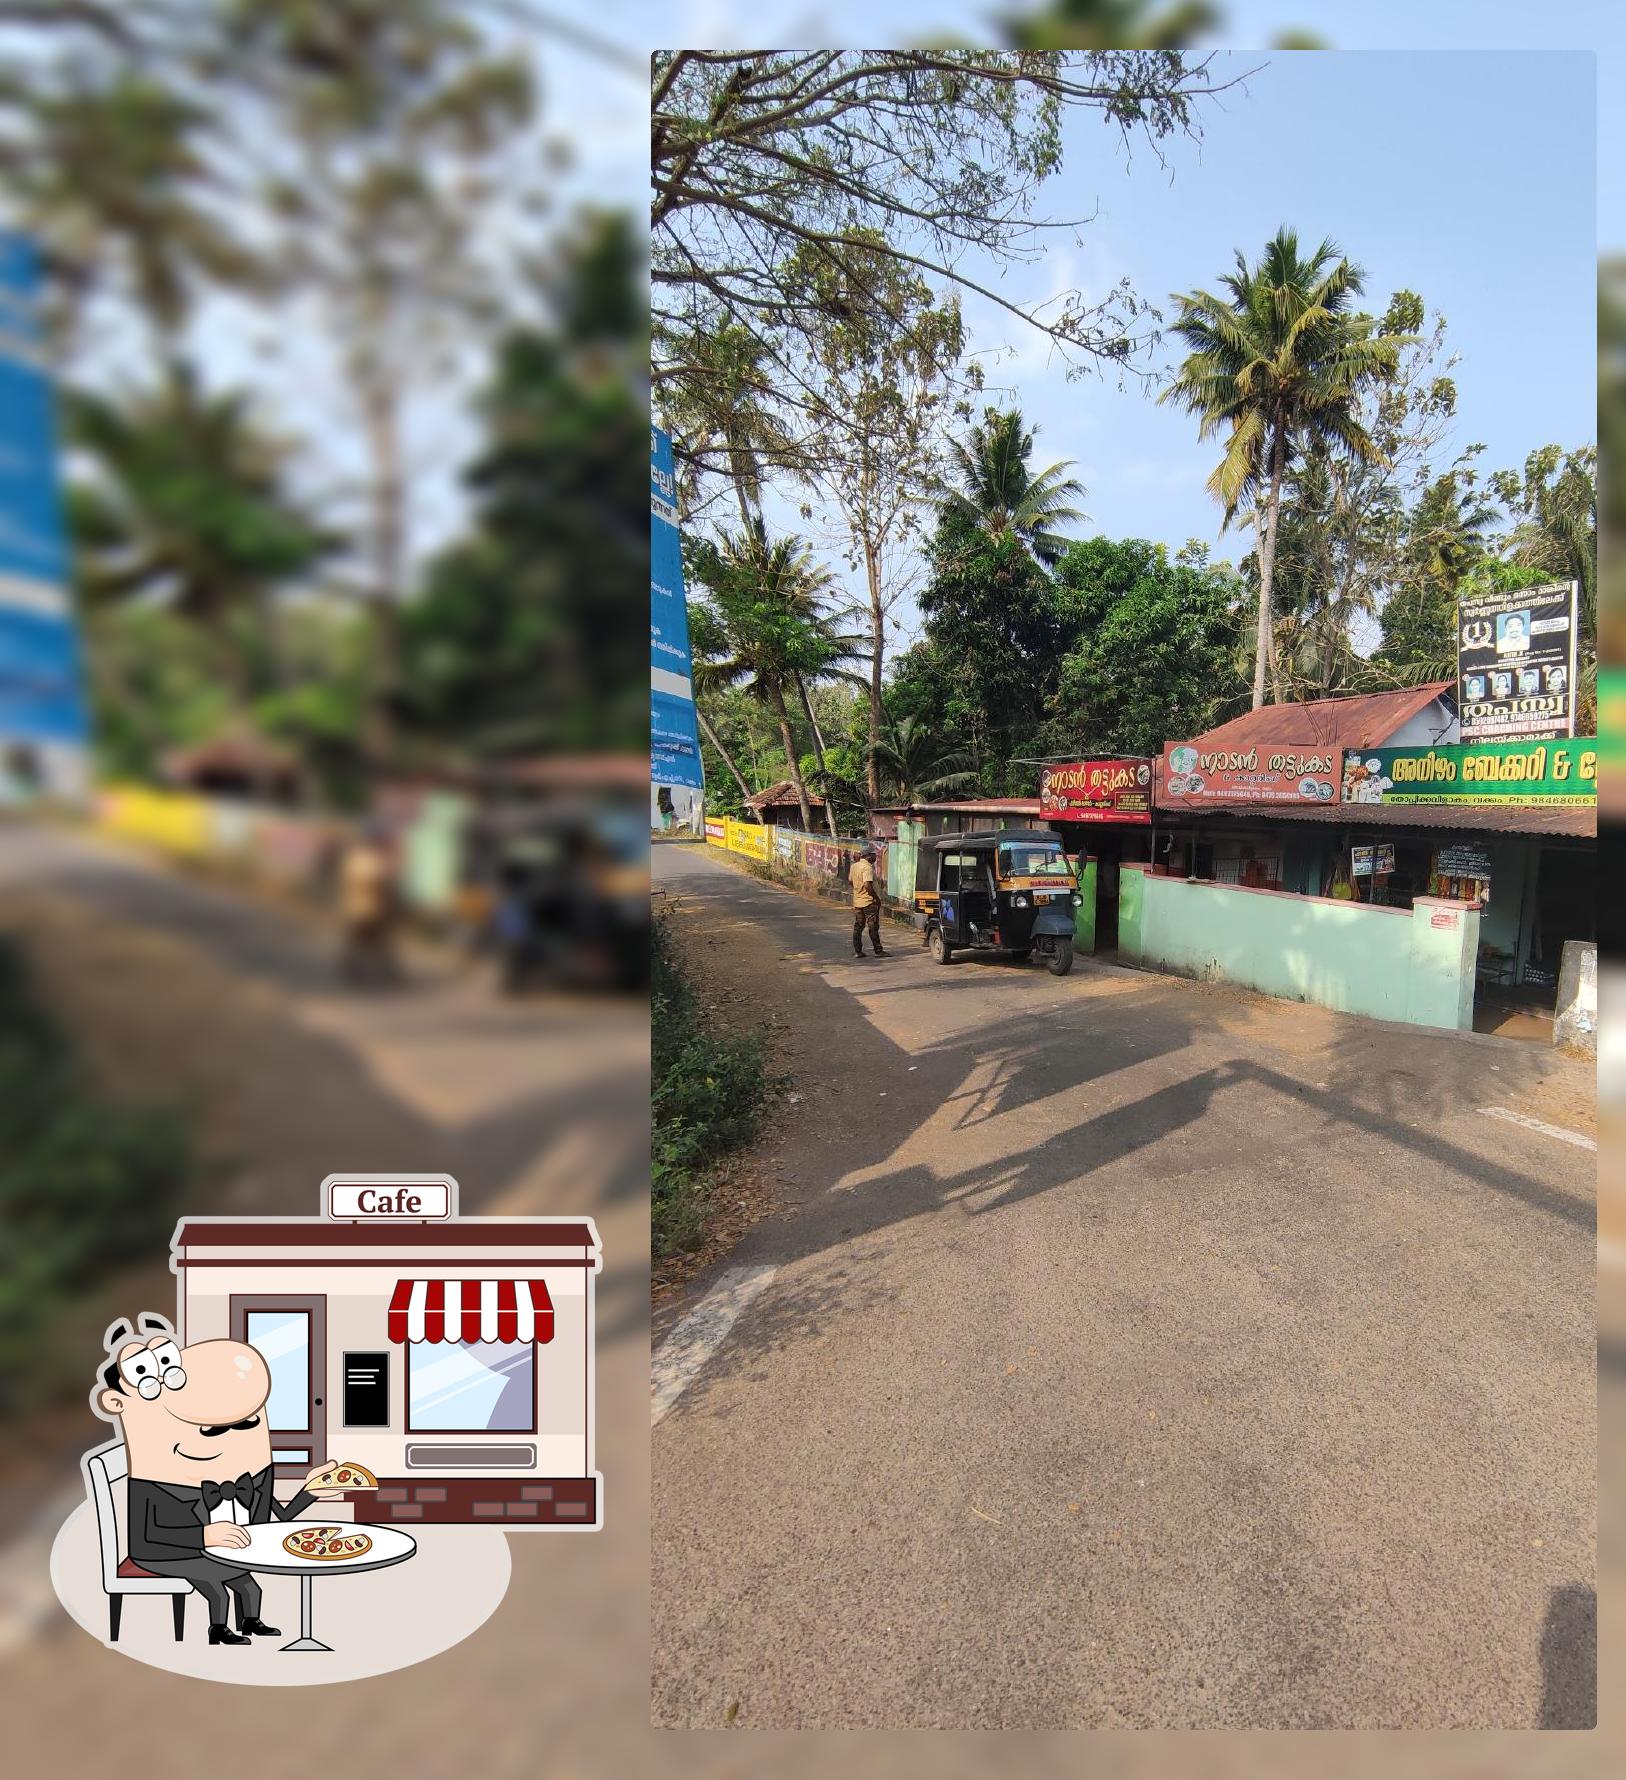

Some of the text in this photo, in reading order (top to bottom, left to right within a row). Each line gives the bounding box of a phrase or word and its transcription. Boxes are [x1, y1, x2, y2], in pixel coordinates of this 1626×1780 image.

[1462, 695, 1565, 718] തപസ്യ
[1461, 718, 1567, 737] PSC COACHING CENTRE
[1267, 752, 1334, 780] തട്ടുകട
[1391, 750, 1458, 783] അനിഴം
[1462, 746, 1547, 782] ബേക്കറി
[1551, 750, 1572, 782] &
[1091, 766, 1135, 796] തട്ടുകട
[1508, 796, 1528, 804] Ph:
